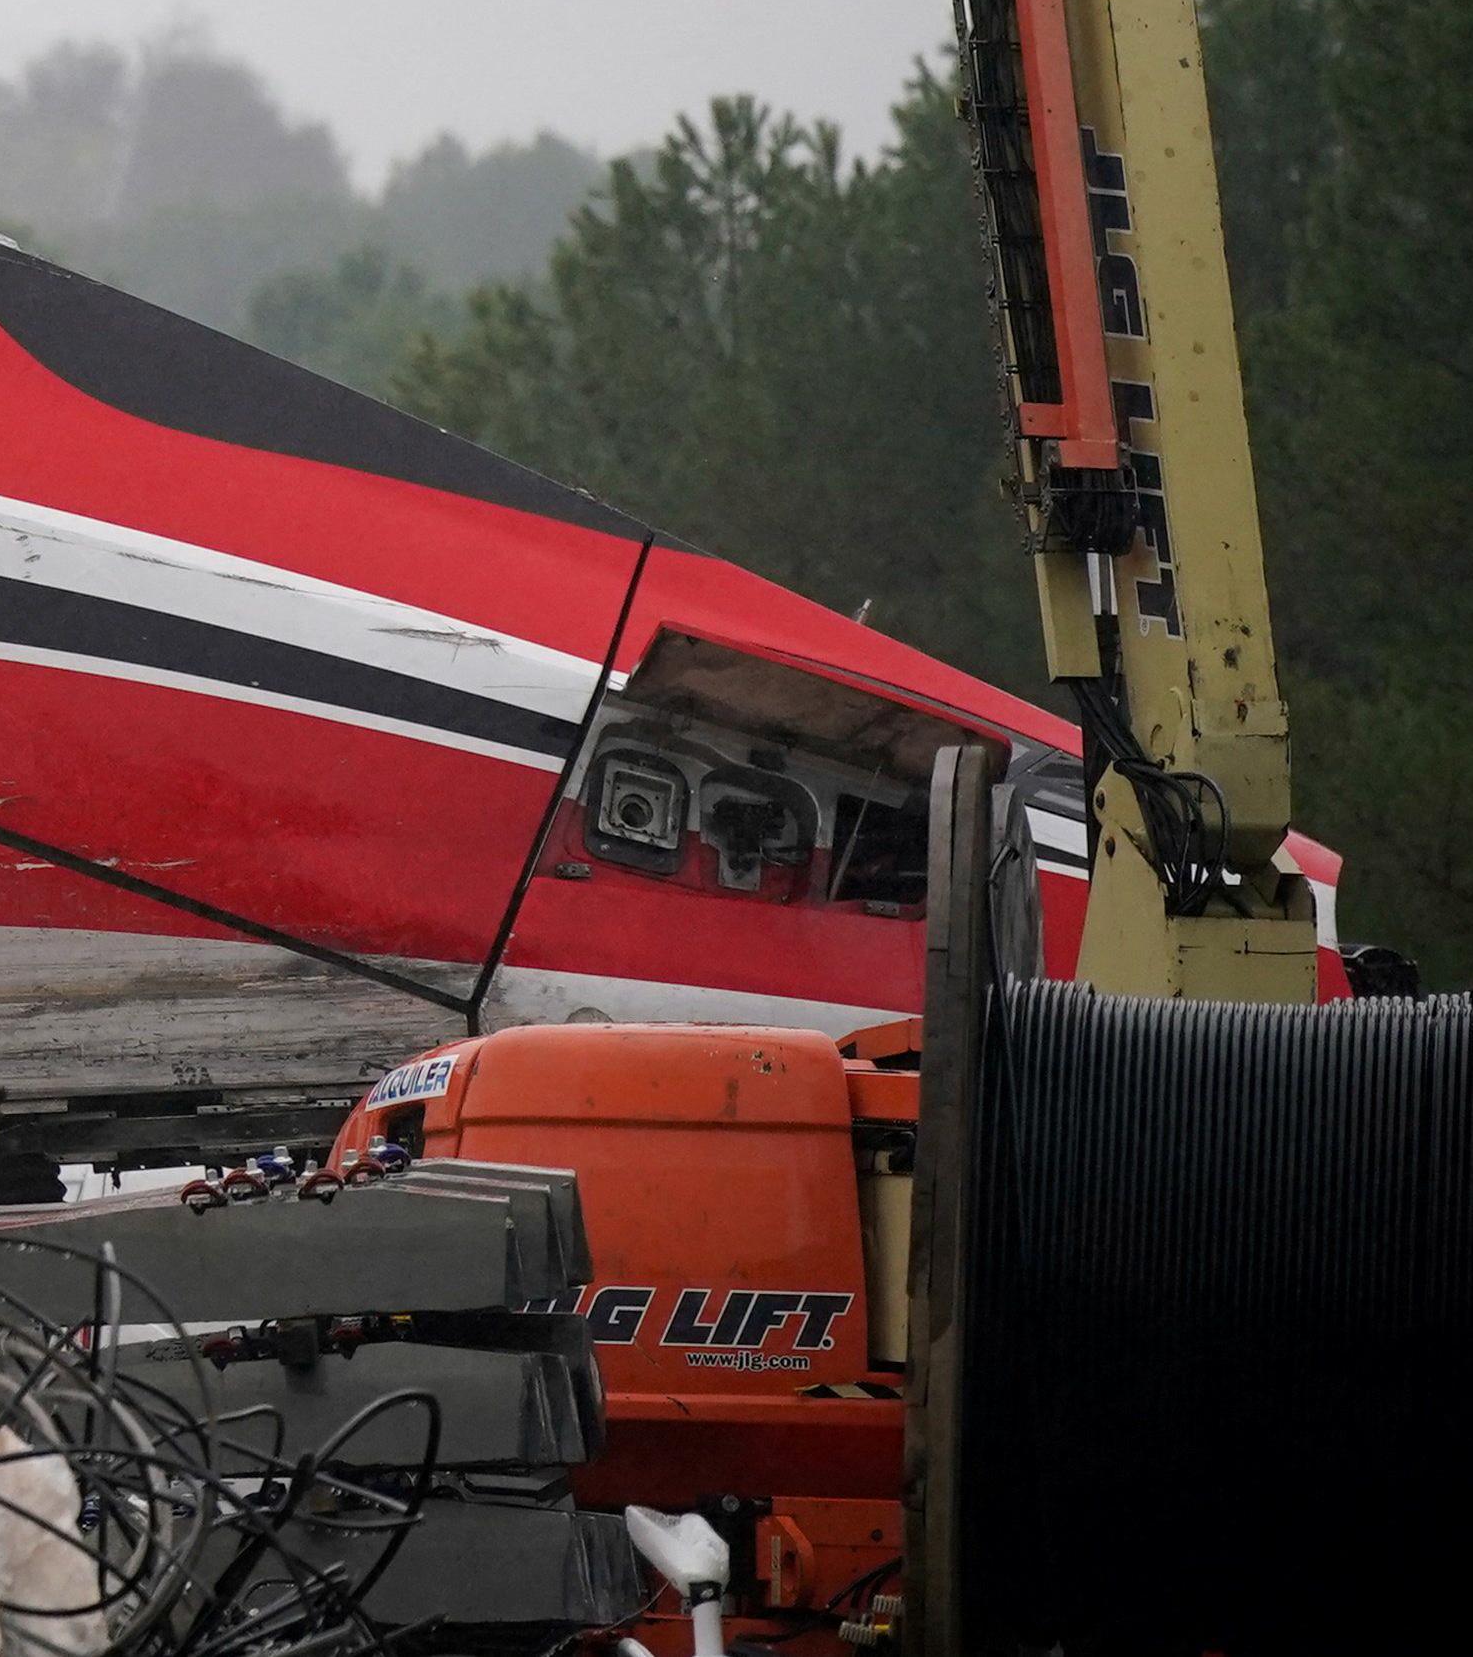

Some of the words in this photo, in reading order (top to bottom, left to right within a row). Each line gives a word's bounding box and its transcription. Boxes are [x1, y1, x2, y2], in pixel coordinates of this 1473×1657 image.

[1081, 126, 1146, 340] JLG
[368, 1060, 452, 1105] ALQUILER
[686, 1351, 811, 1371] www.jlg.com
